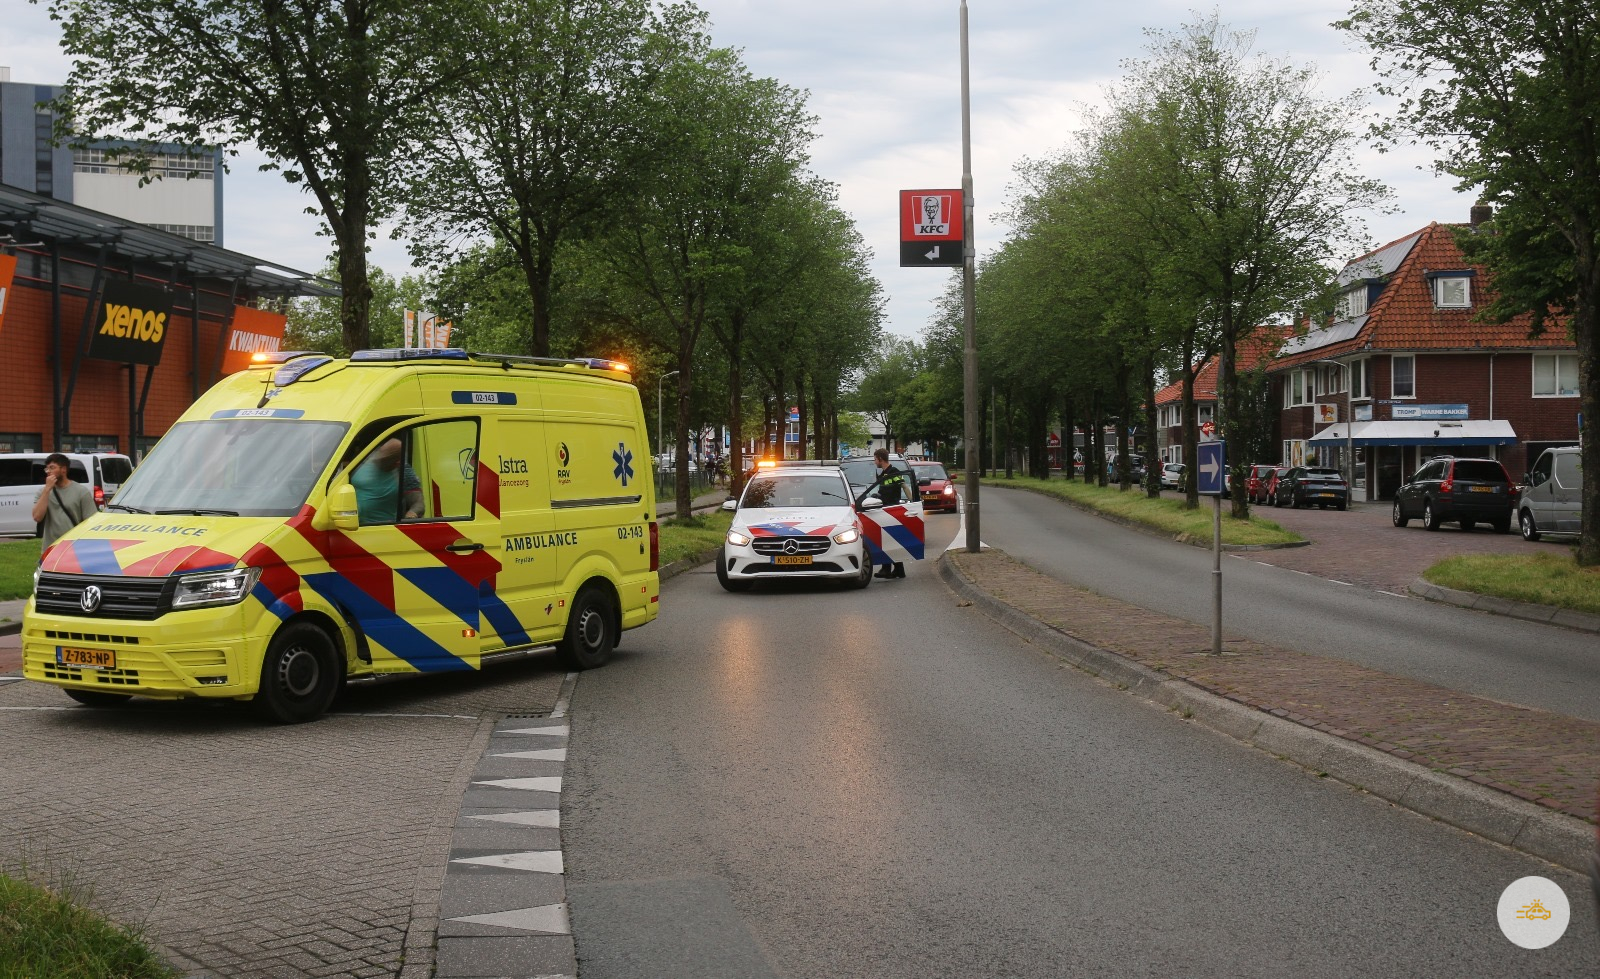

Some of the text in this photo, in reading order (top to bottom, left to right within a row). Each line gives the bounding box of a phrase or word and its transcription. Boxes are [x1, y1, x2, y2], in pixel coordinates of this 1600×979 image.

[920, 225, 944, 234] KFC
[100, 303, 166, 343] xenos
[230, 330, 281, 353] KWANTUM
[475, 394, 495, 402] 02-143
[498, 454, 528, 474] lstra
[557, 469, 571, 478] RAV
[88, 525, 208, 537] AMBULANCE
[617, 525, 643, 540] 02-143
[505, 532, 577, 552] AMBULANCE
[65, 650, 110, 665] Z-783-NP
